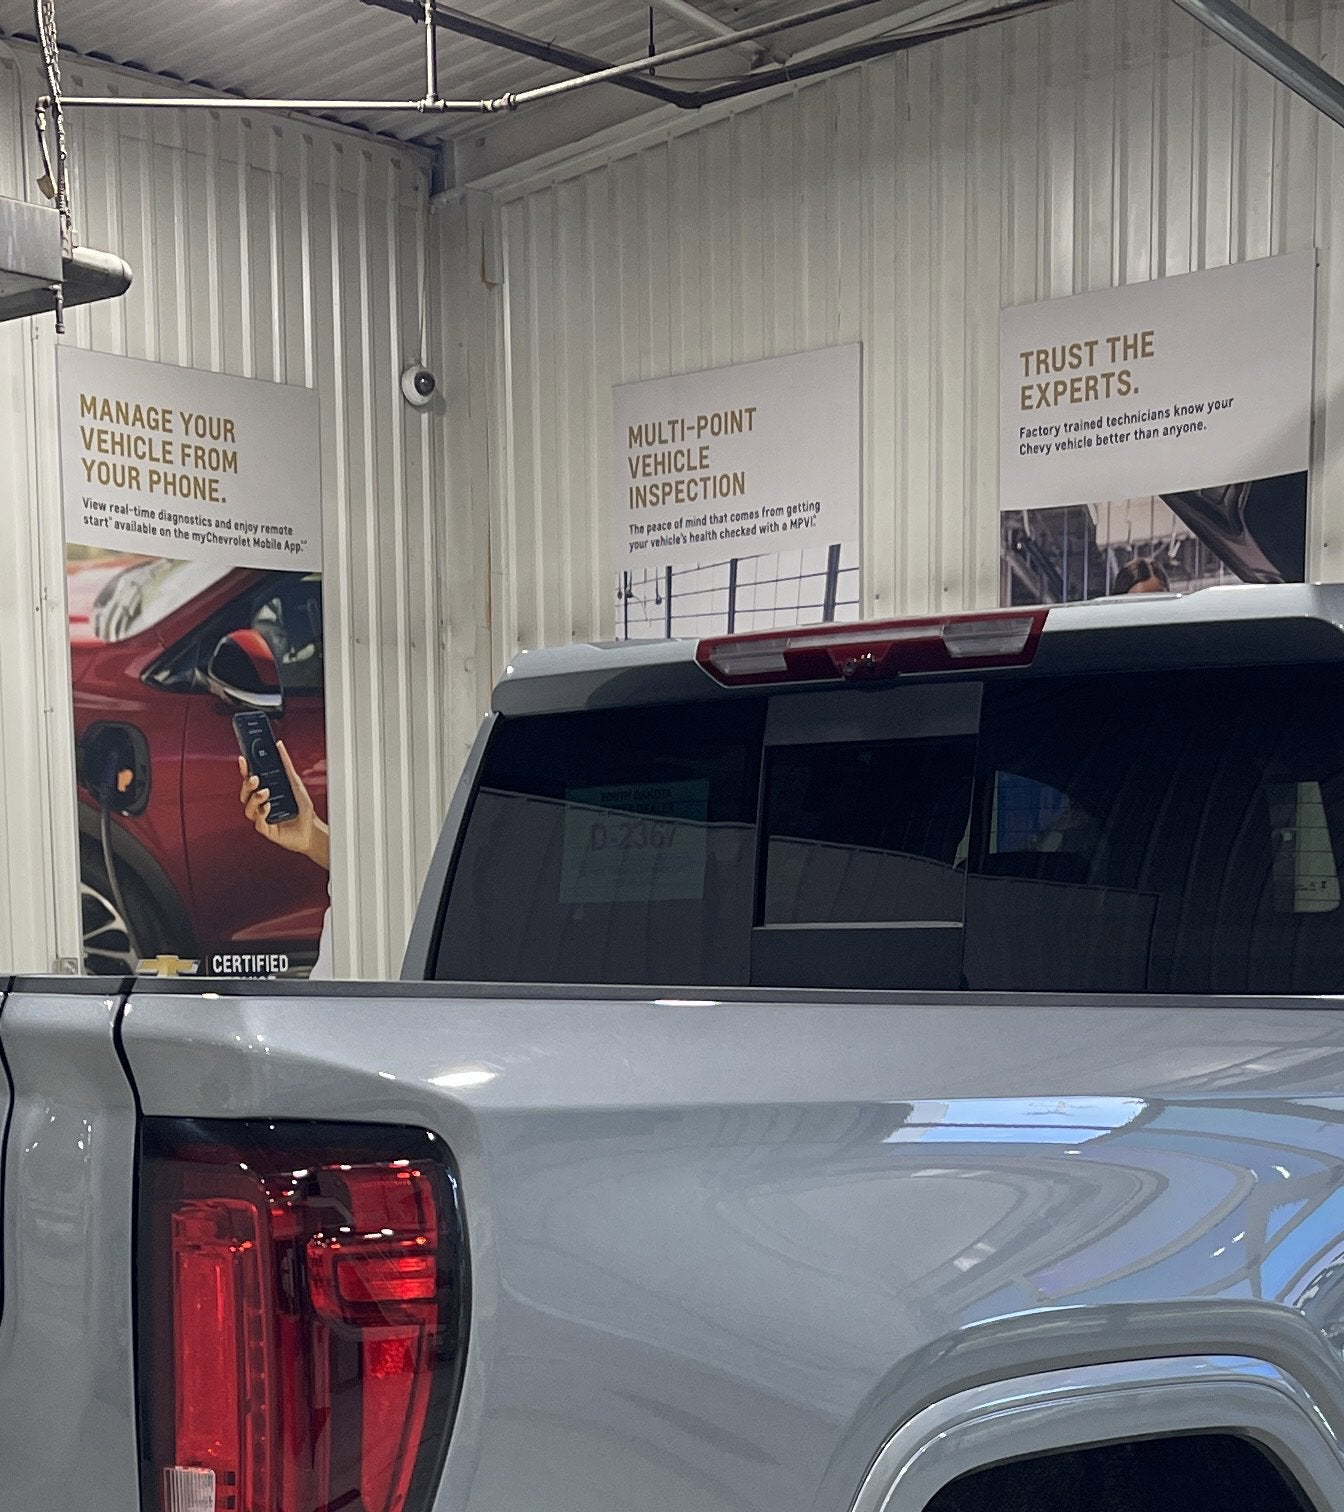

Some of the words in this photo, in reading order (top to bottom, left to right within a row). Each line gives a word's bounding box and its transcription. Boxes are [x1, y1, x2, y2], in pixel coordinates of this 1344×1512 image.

[1019, 339, 1099, 378] TRUST
[1106, 330, 1155, 363] THE
[1021, 369, 1140, 411] EXPERTS.
[79, 393, 173, 434] MANAGE
[180, 411, 236, 444] YOUR
[628, 407, 757, 449] MULTI-POINT
[1019, 424, 1061, 440] Factory
[1063, 415, 1104, 434] trained
[1106, 406, 1171, 428] technicians
[1173, 402, 1205, 418] know
[1206, 396, 1235, 415] your
[1019, 443, 1052, 456] Chevy
[1054, 436, 1093, 452] vehicle
[1095, 432, 1131, 448] better
[1134, 426, 1160, 441] than
[1162, 419, 1208, 438] anyone.
[80, 425, 174, 465] VEHICLE
[181, 443, 239, 474] FROM
[628, 445, 710, 479] VEHICLE
[81, 457, 141, 491] YOUR
[149, 469, 227, 503] PHONE.
[629, 471, 746, 510] INSPECTION
[82, 496, 107, 512] View
[109, 503, 156, 520] real-time
[158, 508, 213, 528] diagnostics
[214, 518, 232, 530] and
[233, 520, 259, 536] enjoy
[260, 524, 293, 536] remote
[114, 520, 157, 536] available
[159, 527, 172, 538] on
[173, 527, 190, 540] the
[192, 531, 251, 548] myChevrolet
[253, 536, 282, 550] Mobile
[629, 524, 645, 535] The
[646, 521, 672, 536] peace
[674, 517, 684, 530] of
[684, 514, 707, 528] mind
[709, 512, 728, 526] that
[730, 509, 760, 523] comes
[761, 505, 785, 519] from
[786, 500, 821, 518] getting
[628, 538, 649, 554] your
[689, 528, 718, 543] health
[719, 524, 757, 540] checked
[758, 520, 780, 534] with
[781, 523, 788, 532] a
[212, 954, 289, 973] CERTIFIED
